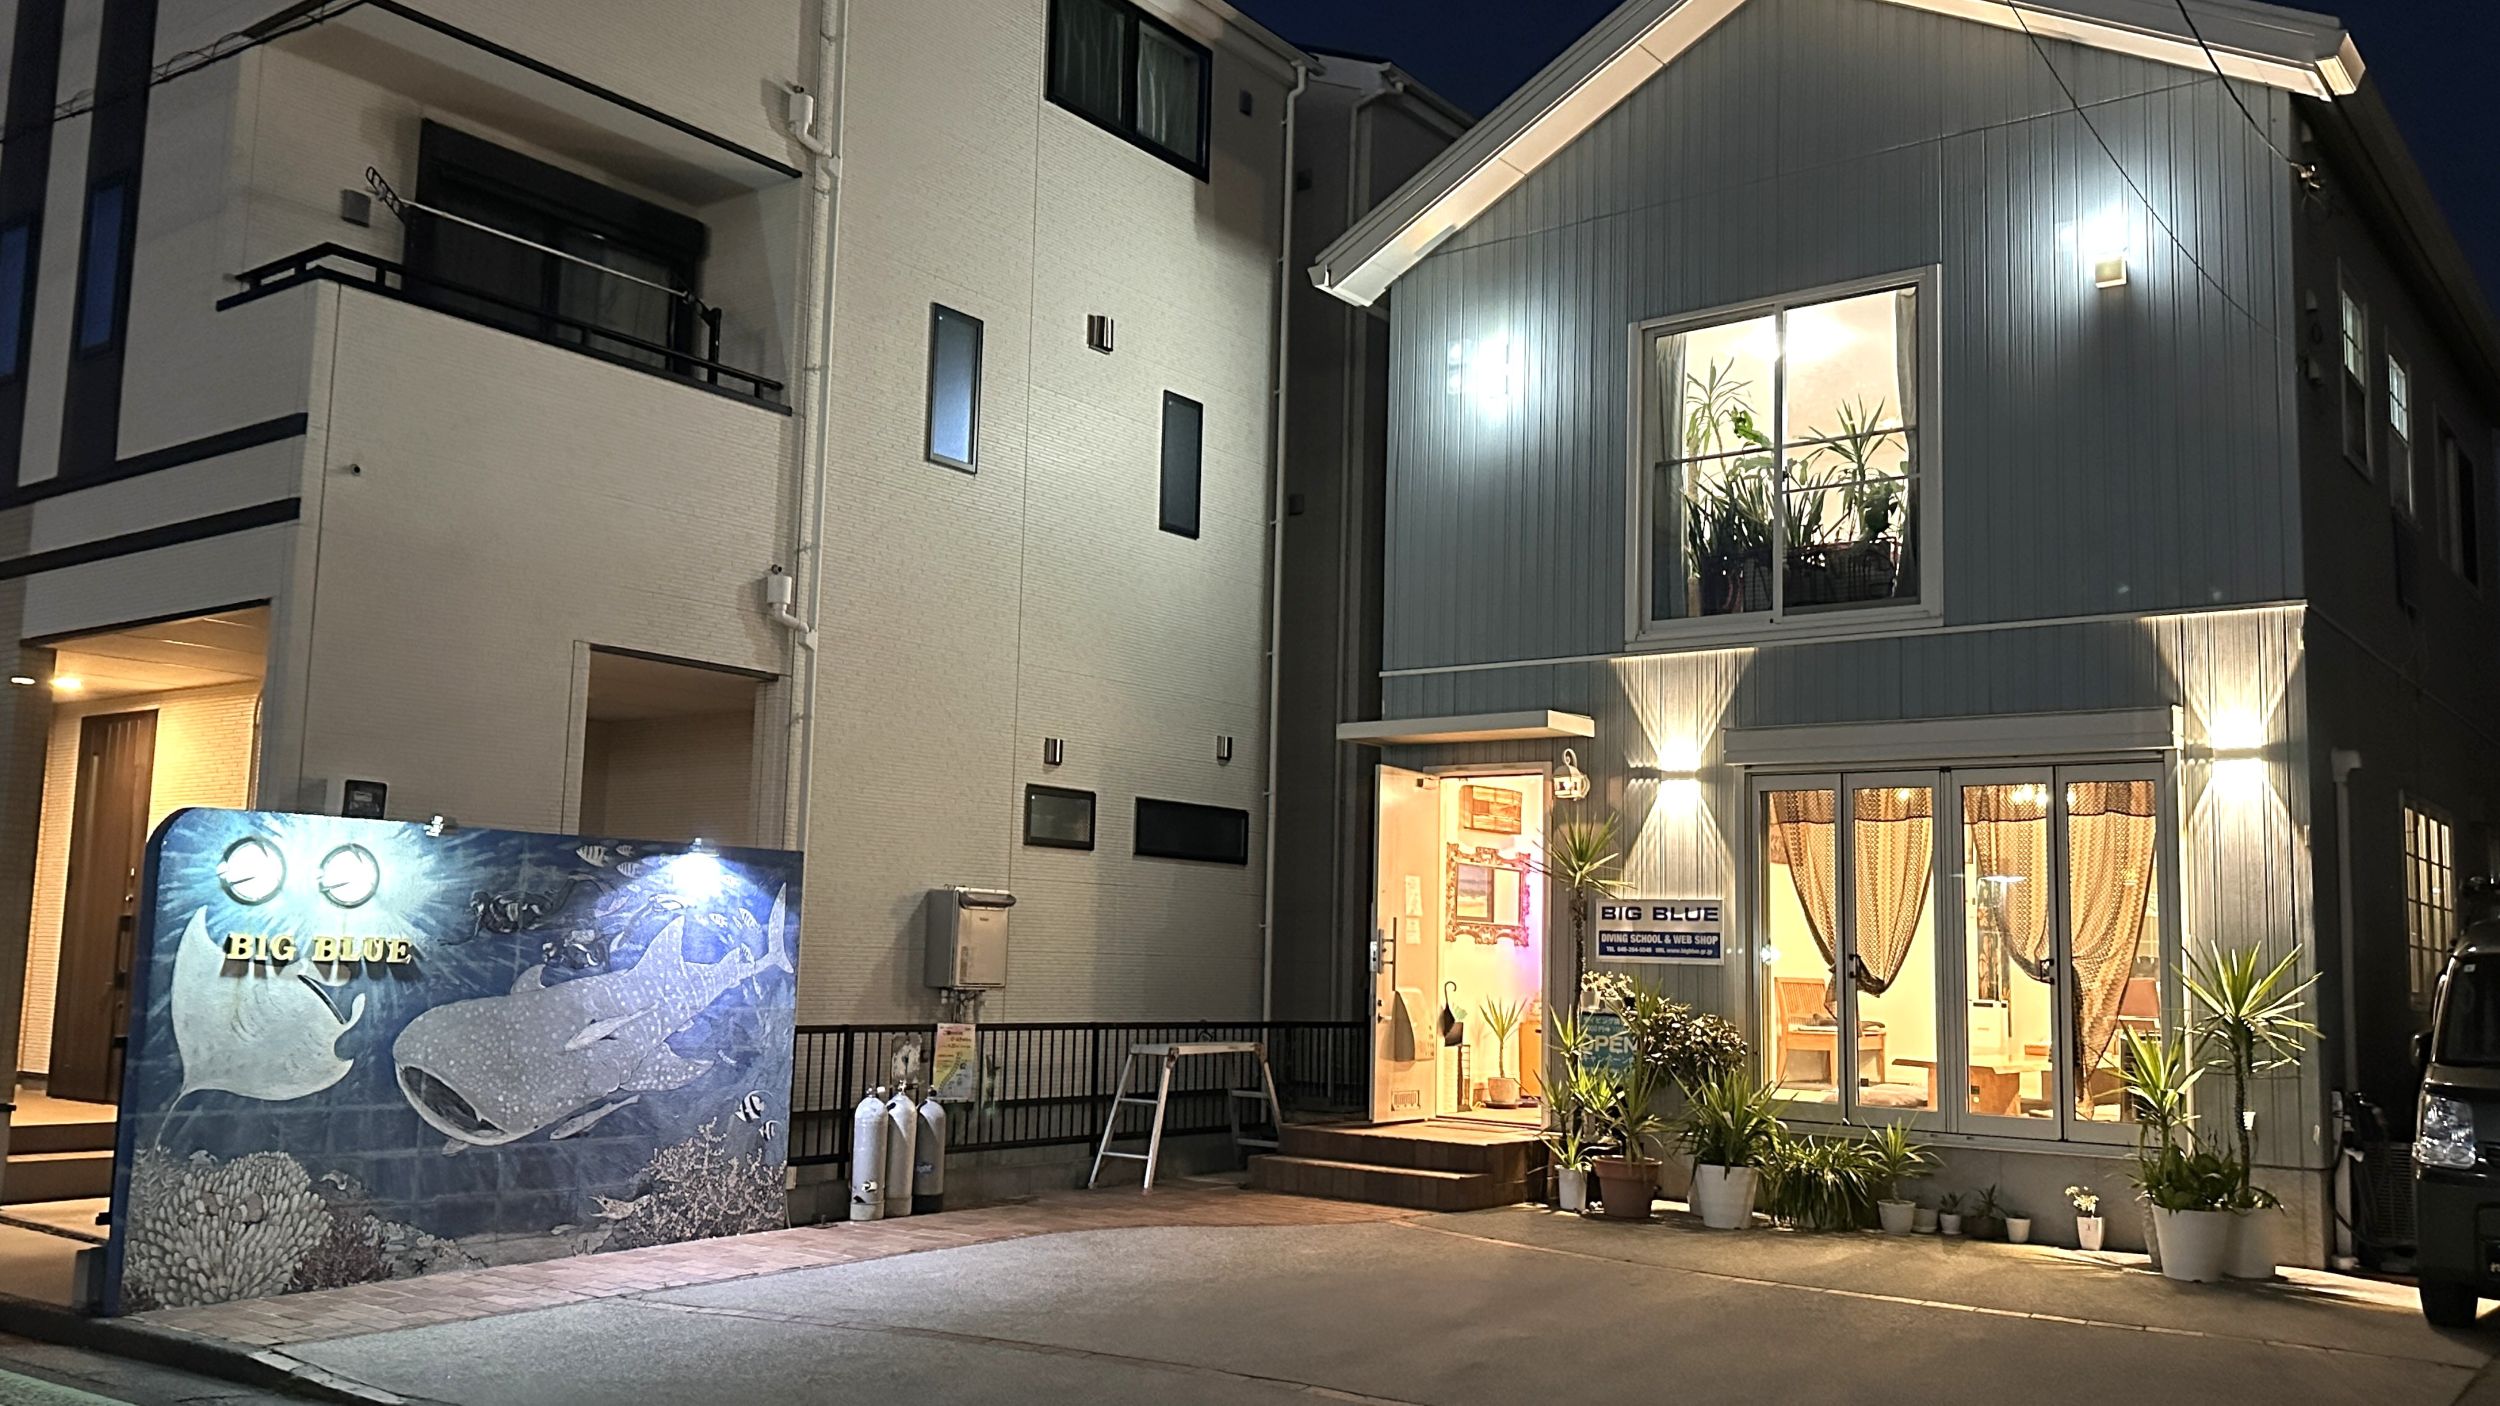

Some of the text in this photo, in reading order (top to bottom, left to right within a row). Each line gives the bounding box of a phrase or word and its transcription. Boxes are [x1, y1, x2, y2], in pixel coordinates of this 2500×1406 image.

[1601, 906, 1719, 922] BIG BLUE
[1601, 933, 1719, 945] DIVING SCHOOL & WEB SHOP
[227, 932, 413, 965] BIG BLUE
[1581, 1034, 1639, 1054] OPEN
